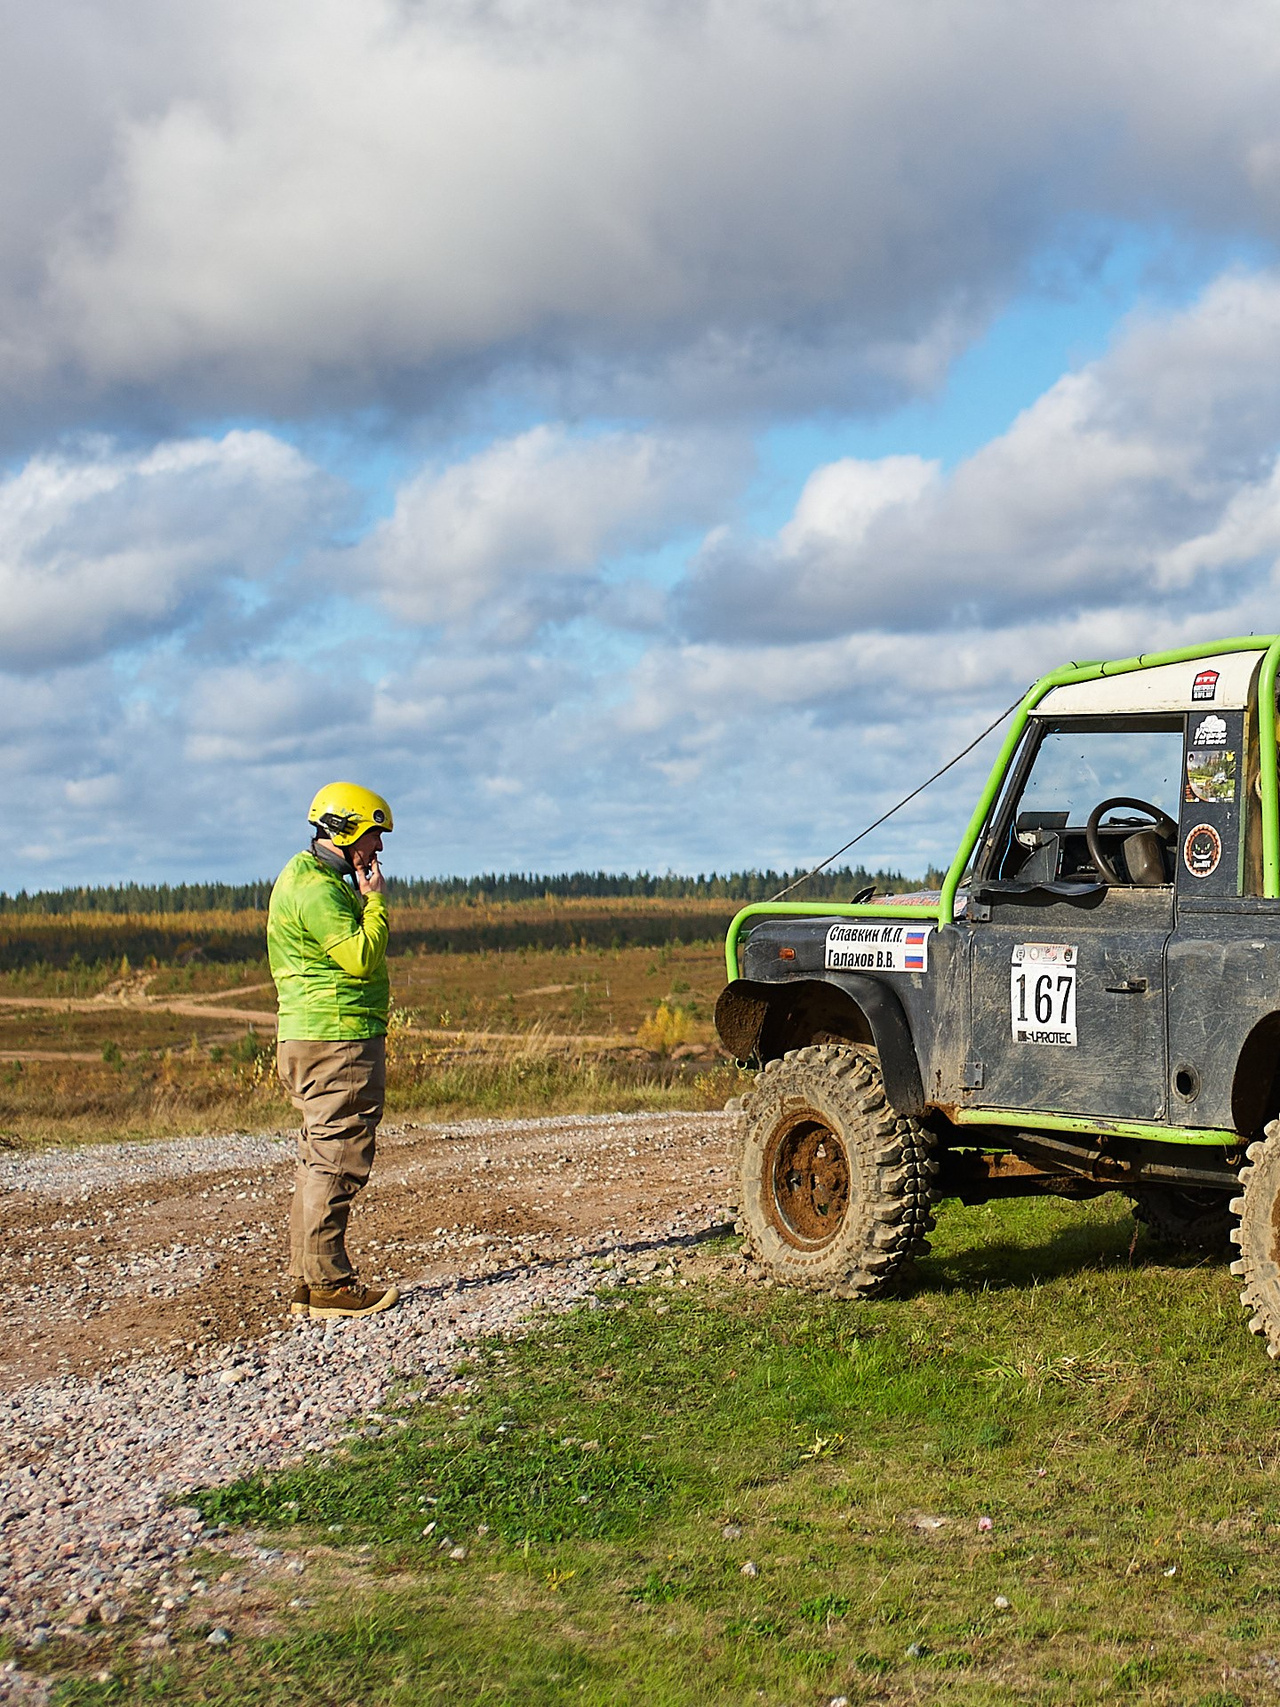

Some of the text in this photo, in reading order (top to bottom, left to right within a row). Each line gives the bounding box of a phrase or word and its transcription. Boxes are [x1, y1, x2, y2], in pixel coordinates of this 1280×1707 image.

[829, 926, 904, 943] Славкин М.П.
[828, 949, 896, 968] Галахов В.В.
[1016, 973, 1073, 1024] 167
[1026, 1031, 1072, 1044] SUPROTEC
